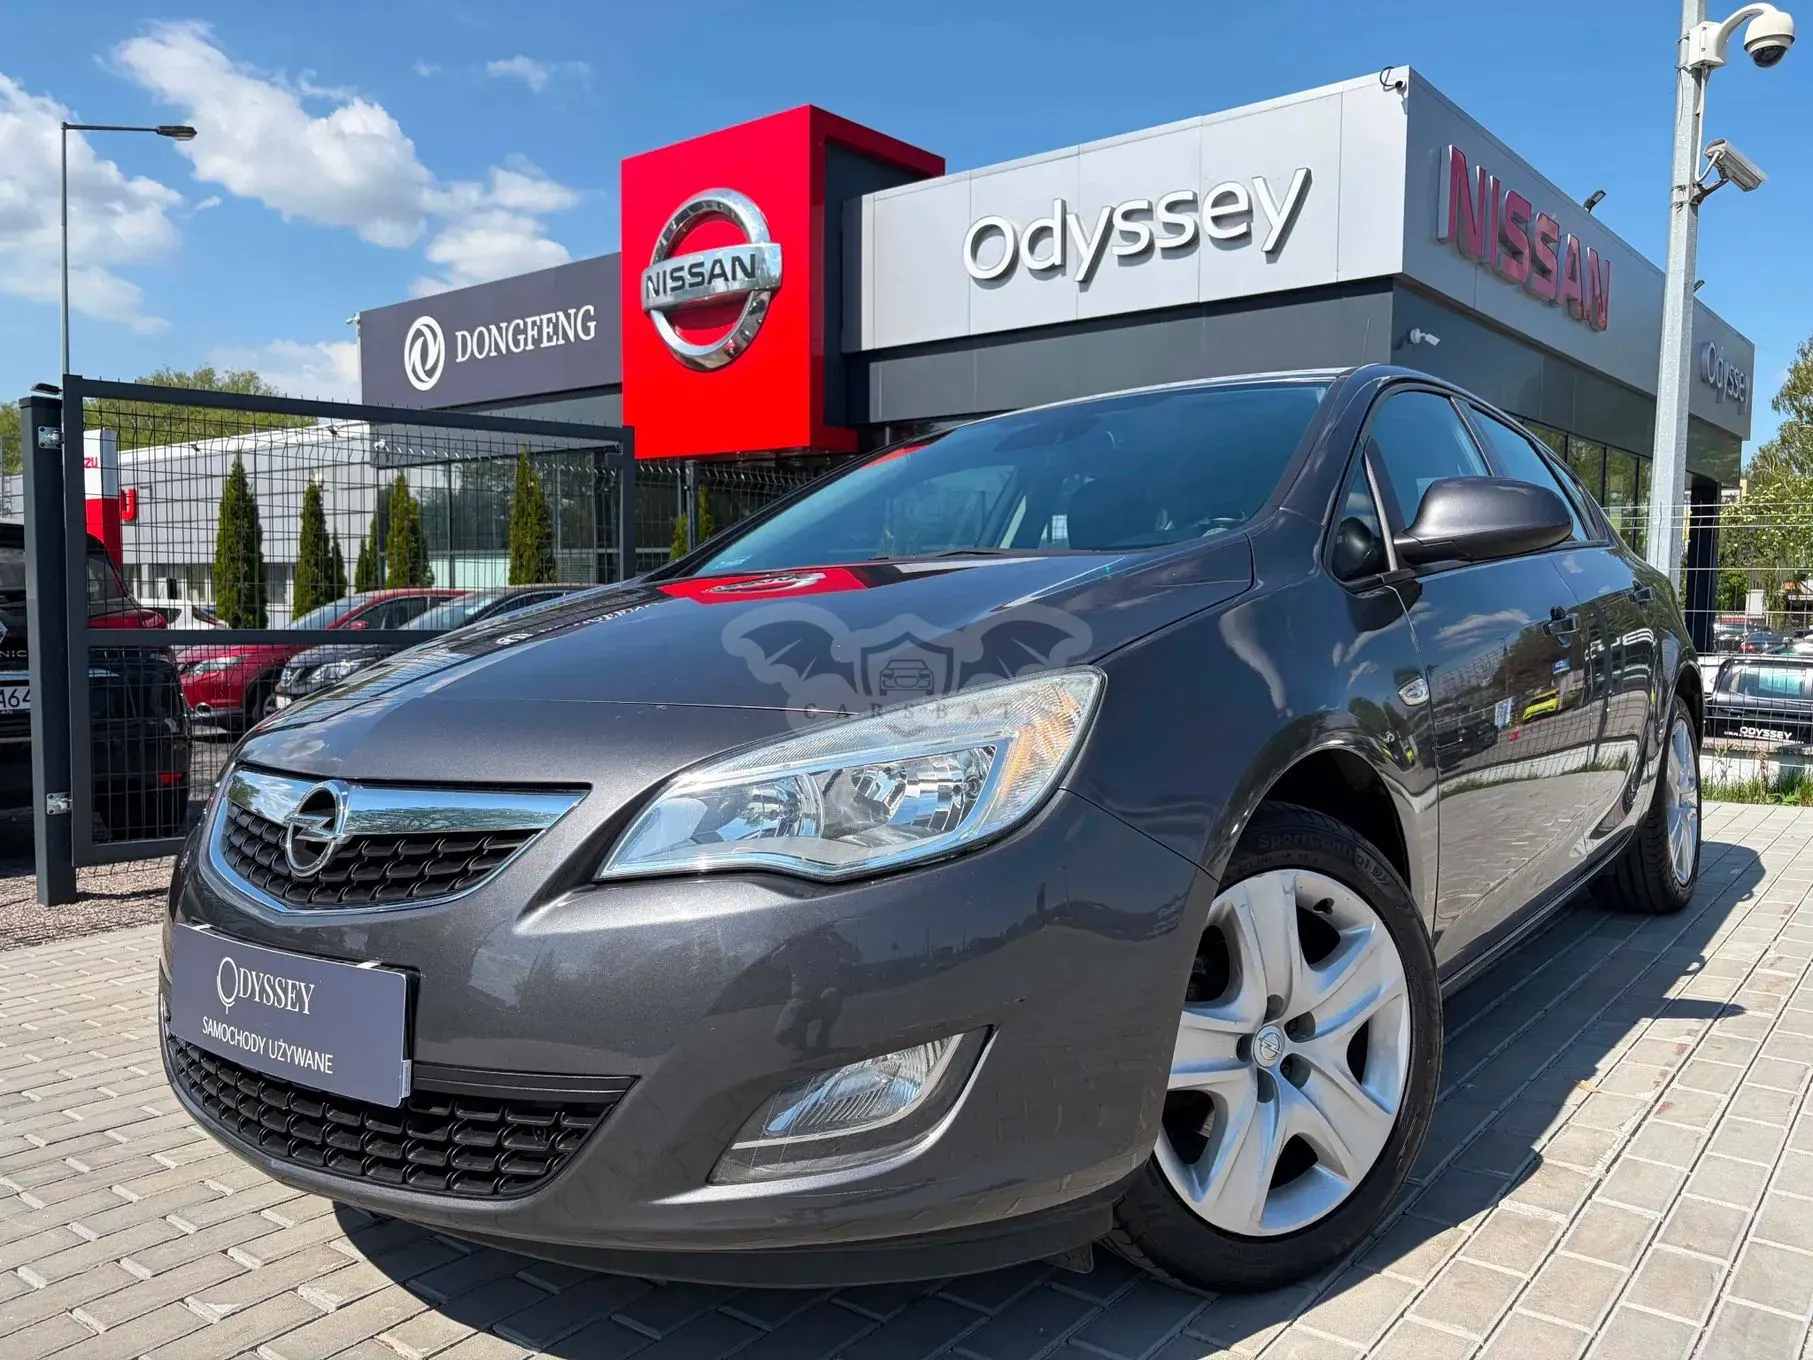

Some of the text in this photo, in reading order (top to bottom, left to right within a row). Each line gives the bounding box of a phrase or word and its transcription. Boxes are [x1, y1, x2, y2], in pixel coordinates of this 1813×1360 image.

[962, 168, 1312, 284] Odyssey
[1437, 145, 1611, 332] NISSAN
[645, 253, 757, 300] NISSAN
[455, 305, 597, 362] DONGFENG
[1740, 726, 1792, 740] ODYSSEY
[216, 956, 315, 1015] ODYSSEY
[202, 1015, 334, 1075] SAMOCHODY UŻYWANE
